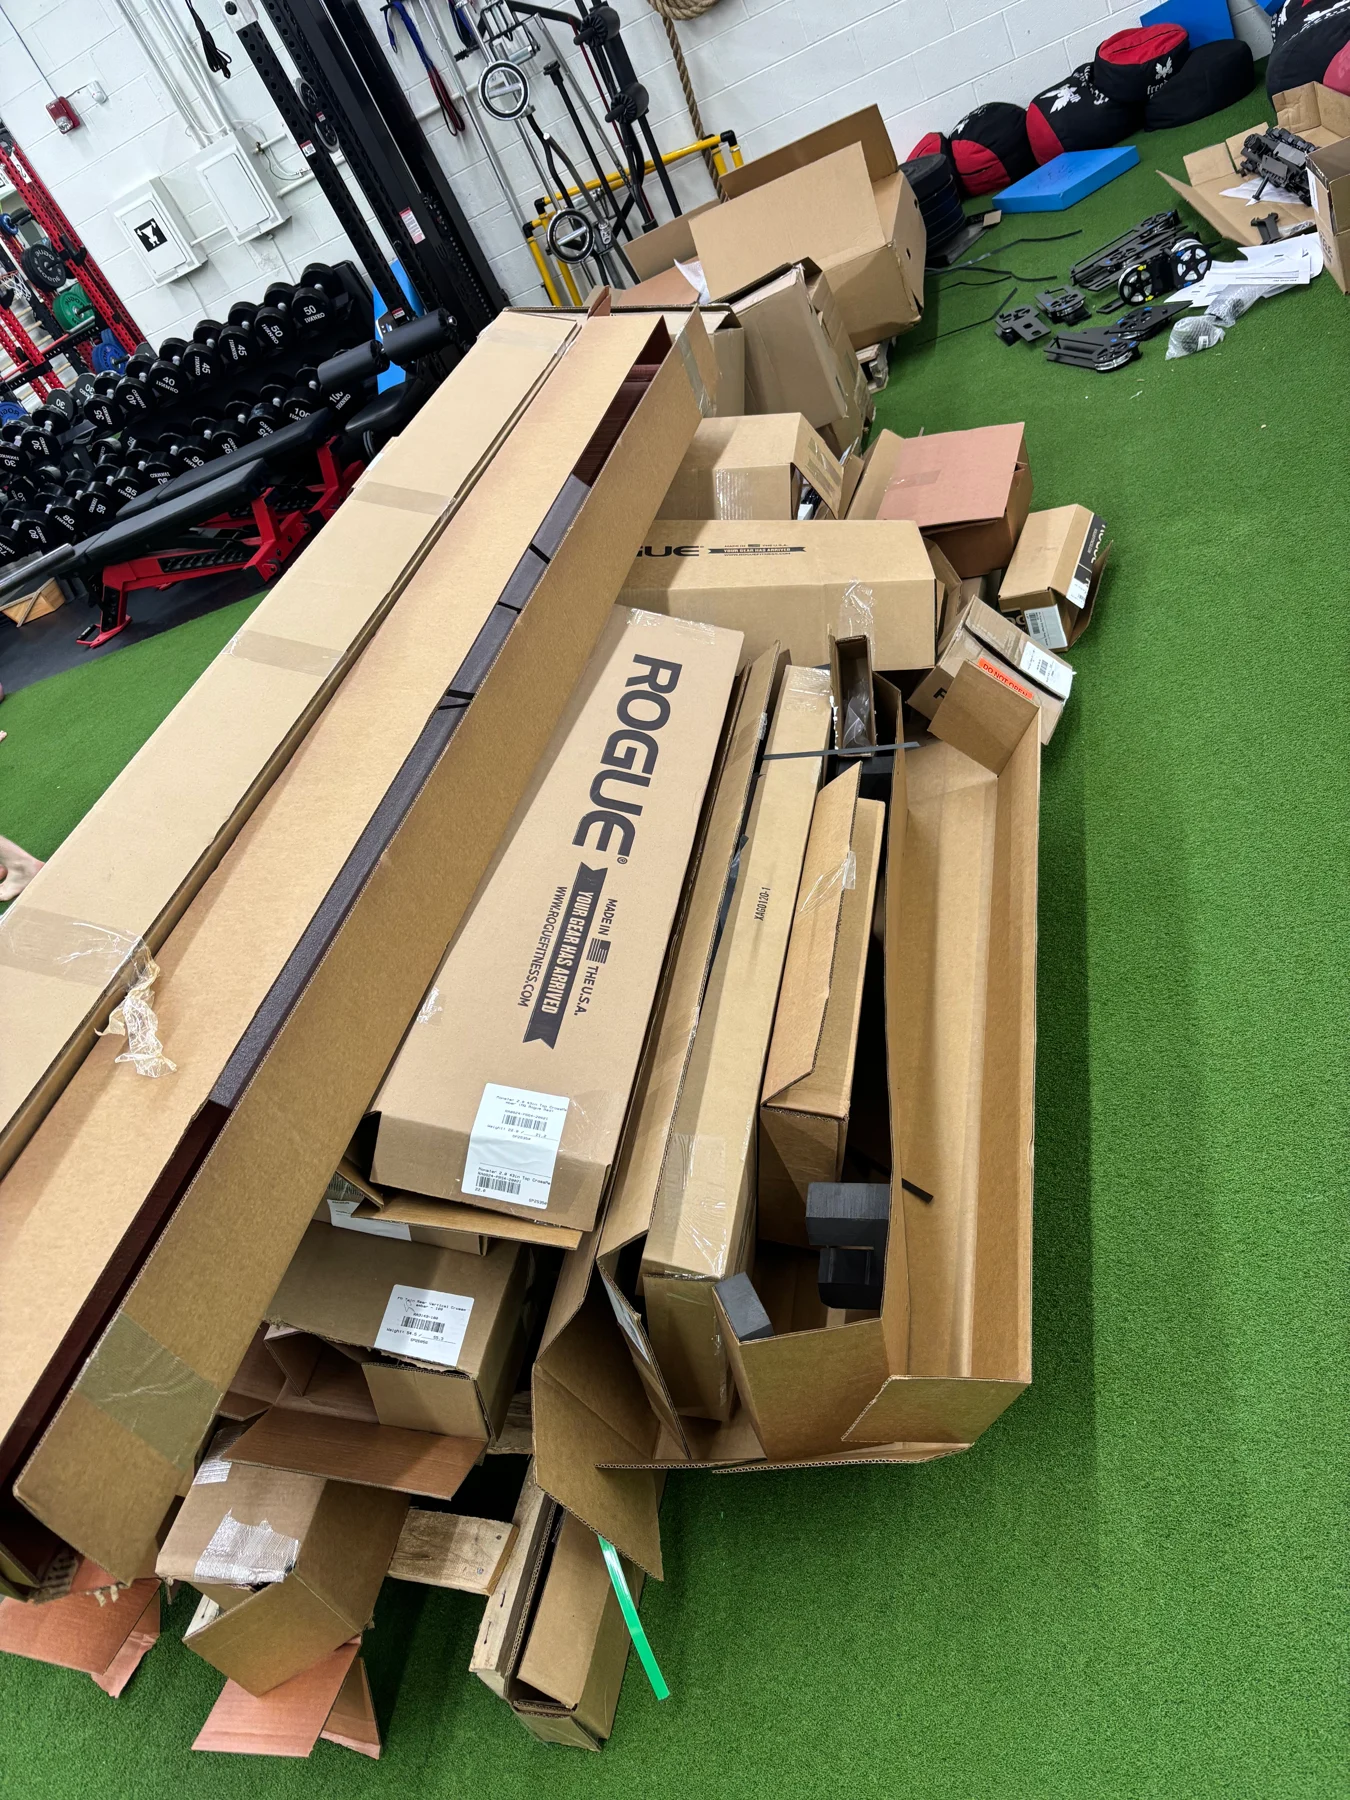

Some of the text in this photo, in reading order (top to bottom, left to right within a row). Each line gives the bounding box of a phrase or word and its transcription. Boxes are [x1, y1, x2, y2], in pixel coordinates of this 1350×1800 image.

[303, 305, 317, 316] 50
[270, 325, 284, 337] 50
[237, 344, 248, 356] 45
[201, 362, 212, 375] 45
[162, 376, 176, 387] 40
[55, 398, 66, 410] 30
[126, 394, 138, 406] 40
[93, 409, 105, 421] 35
[31, 440, 42, 451] 30
[983, 663, 994, 674] DO
[994, 671, 1009, 684] NOT
[518, 886, 568, 1008] WWW.ROGUEFITNESS.COM
[541, 891, 594, 1015] YOUR GEAR HAS ARRIVED
[574, 898, 618, 1016] MADE IN THE U.S.A.
